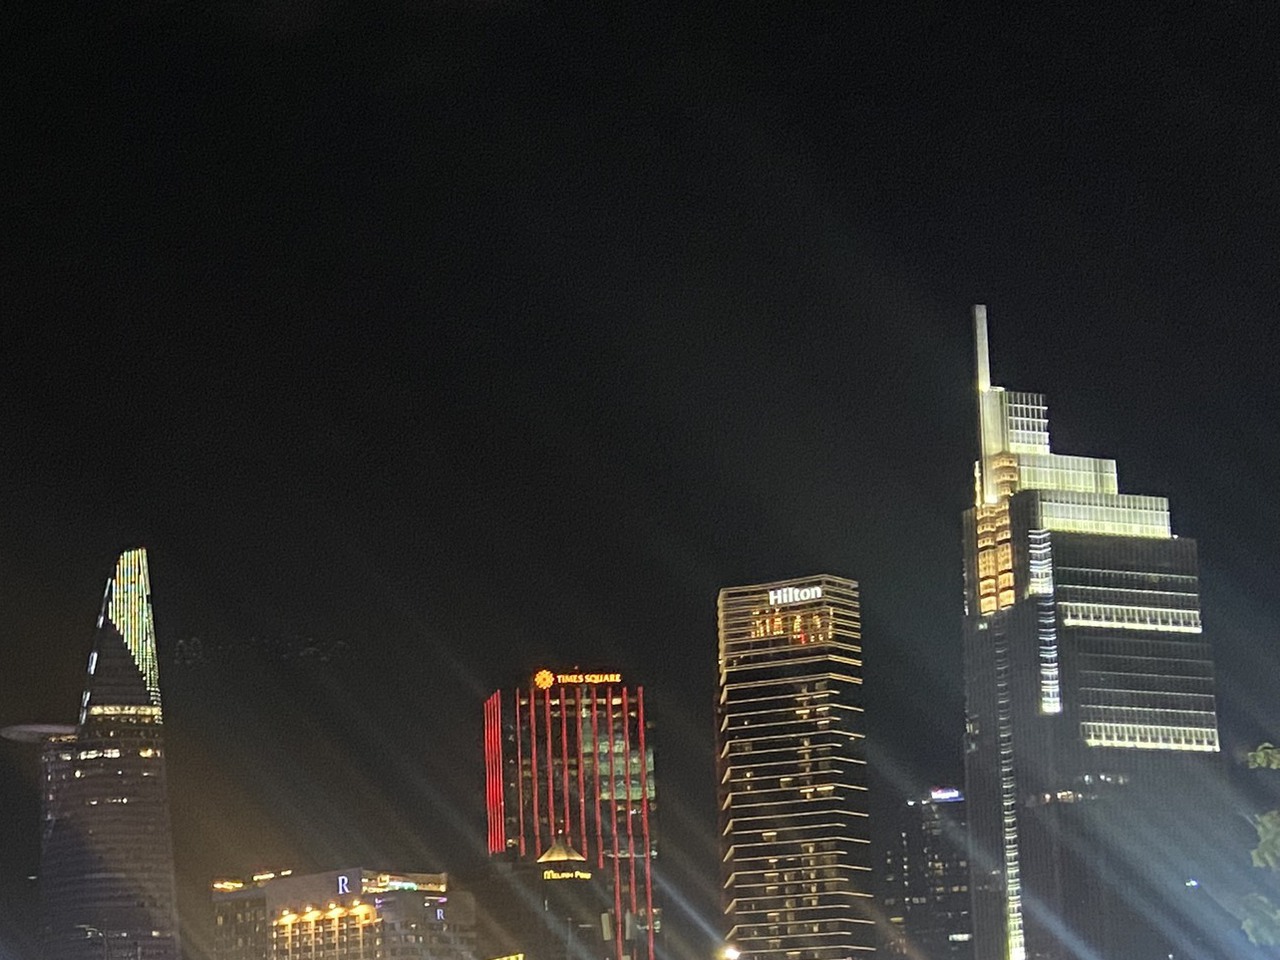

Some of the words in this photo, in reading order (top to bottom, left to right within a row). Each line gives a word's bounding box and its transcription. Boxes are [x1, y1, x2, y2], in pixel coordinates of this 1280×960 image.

[769, 585, 822, 605] Hilton
[557, 674, 584, 684] TIMES
[584, 673, 622, 684] SQUARE
[338, 875, 350, 894] R
